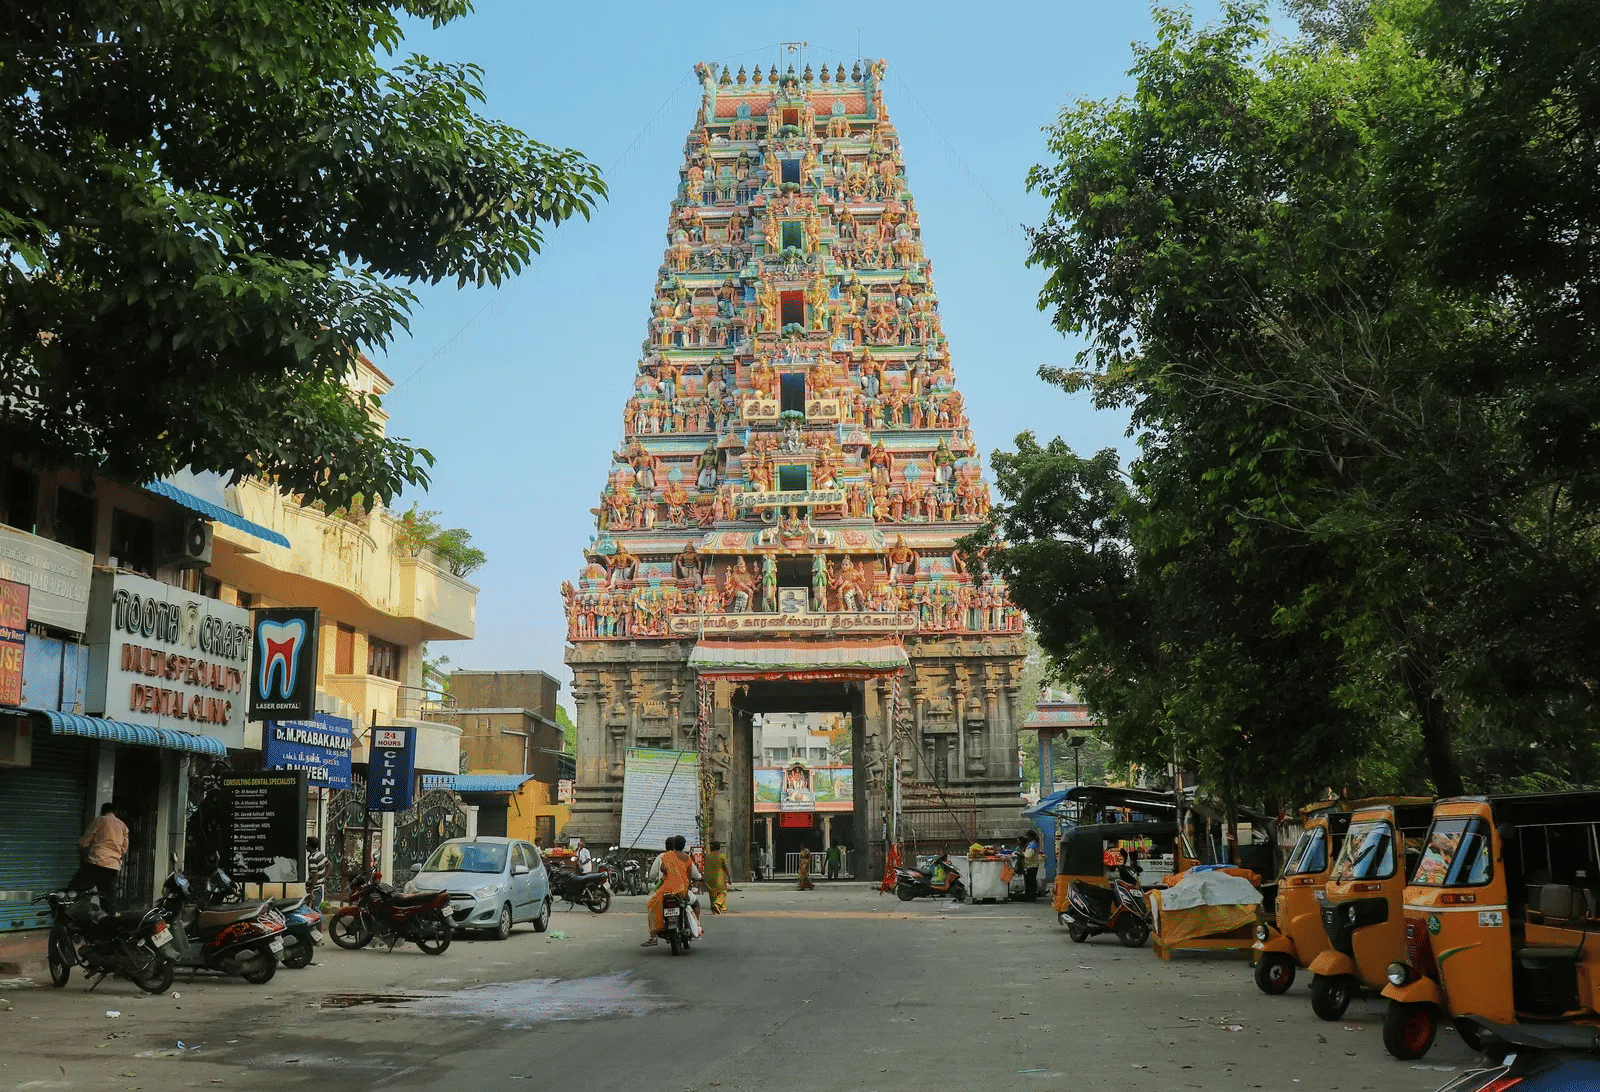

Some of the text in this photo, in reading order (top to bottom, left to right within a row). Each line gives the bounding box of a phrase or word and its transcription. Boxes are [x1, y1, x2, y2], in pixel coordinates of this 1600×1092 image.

[114, 588, 252, 661] TOOTH CRAFT
[130, 683, 232, 726] DENTAL CLINIC
[256, 702, 300, 710] LASER DENTAL
[276, 728, 286, 741] Dr.
[384, 732, 396, 740] 24
[380, 751, 397, 804] CLINIC
